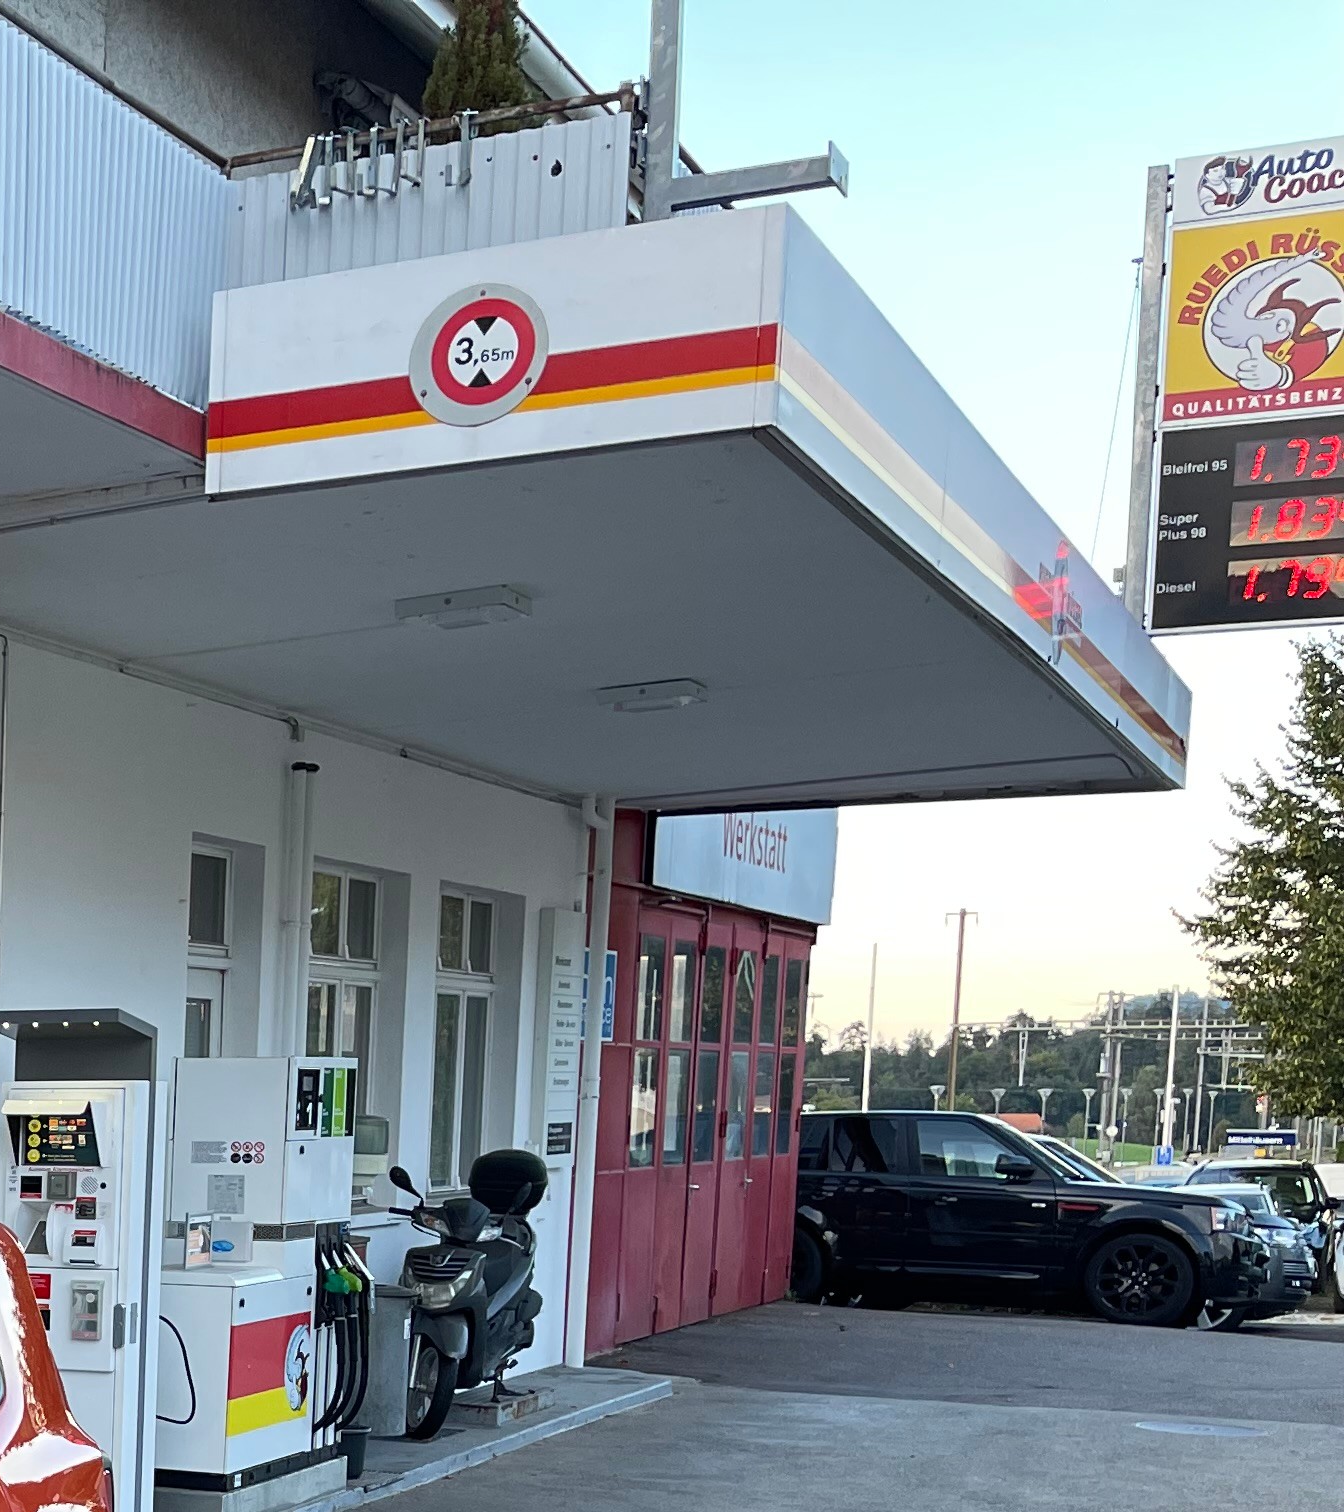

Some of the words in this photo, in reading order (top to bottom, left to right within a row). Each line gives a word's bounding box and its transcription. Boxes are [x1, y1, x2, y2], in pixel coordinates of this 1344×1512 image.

[1251, 148, 1334, 187] Auto
[1177, 240, 1260, 326] RUEDI
[1162, 461, 1209, 476] Bleifrei
[1211, 460, 1228, 471] 95
[1249, 434, 1344, 482] 1.73
[1159, 513, 1199, 527] Super
[1247, 496, 1344, 541] 1.83
[1159, 529, 1187, 541] Plus
[1190, 527, 1207, 539] 98
[1156, 581, 1196, 594] Diesel
[722, 812, 788, 874] Werkstatt
